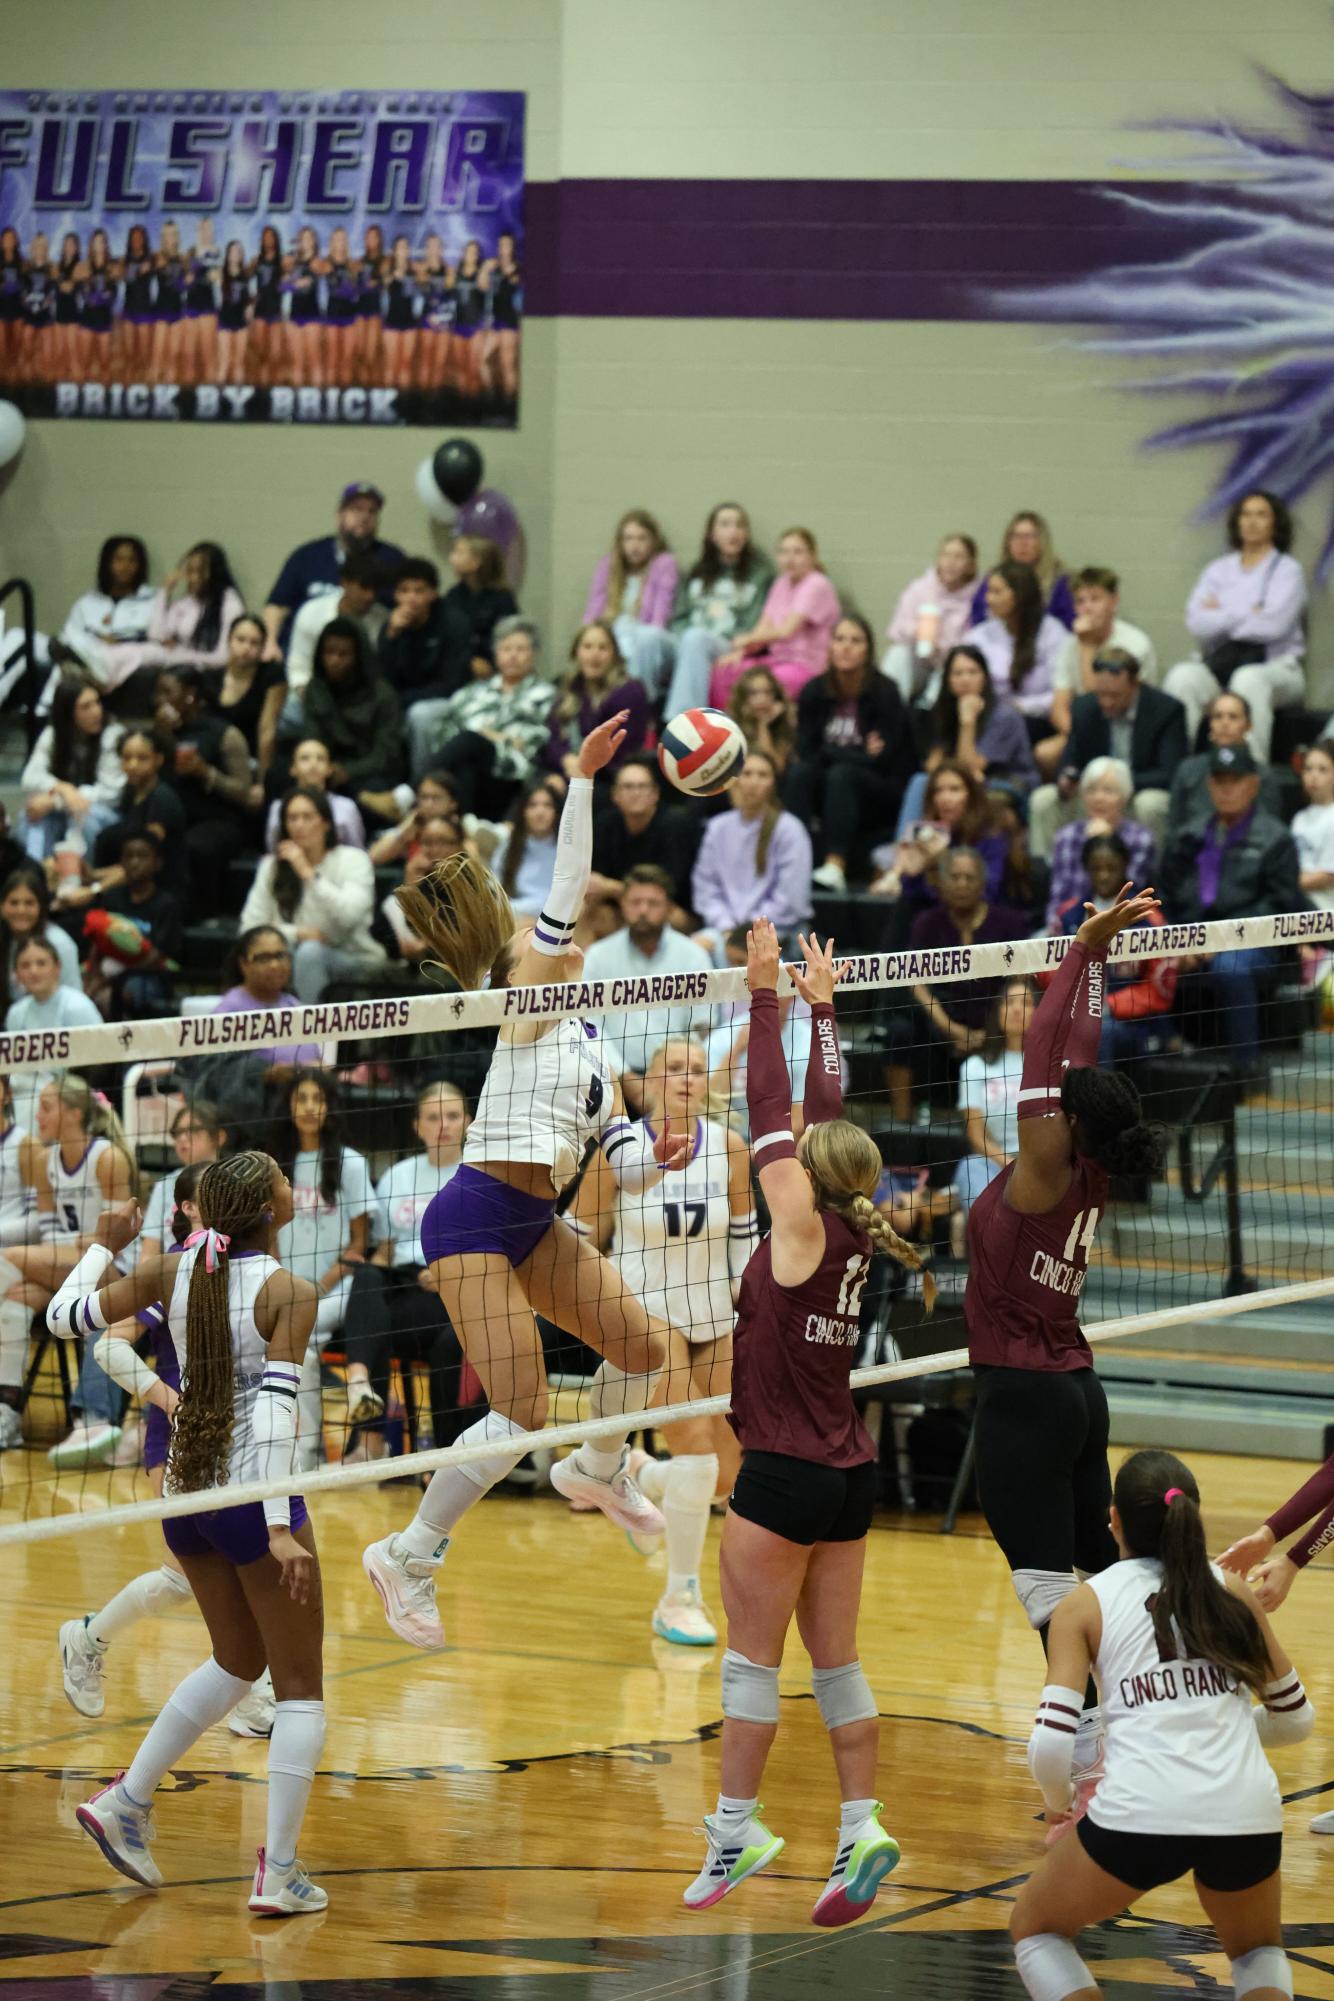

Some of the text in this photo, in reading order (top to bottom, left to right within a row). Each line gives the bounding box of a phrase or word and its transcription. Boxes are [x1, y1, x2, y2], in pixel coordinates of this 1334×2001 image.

[56, 382, 399, 423] BRICK BY BRICK
[1129, 924, 1207, 955] CHARGERS
[886, 949, 971, 980] CHARGERS
[504, 972, 708, 1017] FULSHEAR CHARGERS
[1088, 961, 1103, 1018] COUGARS
[179, 1000, 410, 1048] FULSHEAR CHARGERS
[817, 1018, 840, 1076] COUGARS
[664, 1203, 706, 1238] 17
[1063, 1207, 1099, 1265] 14
[1029, 1250, 1075, 1294] CINCO
[805, 1314, 845, 1346] CINCO
[1119, 1668, 1178, 1709] CINCO
